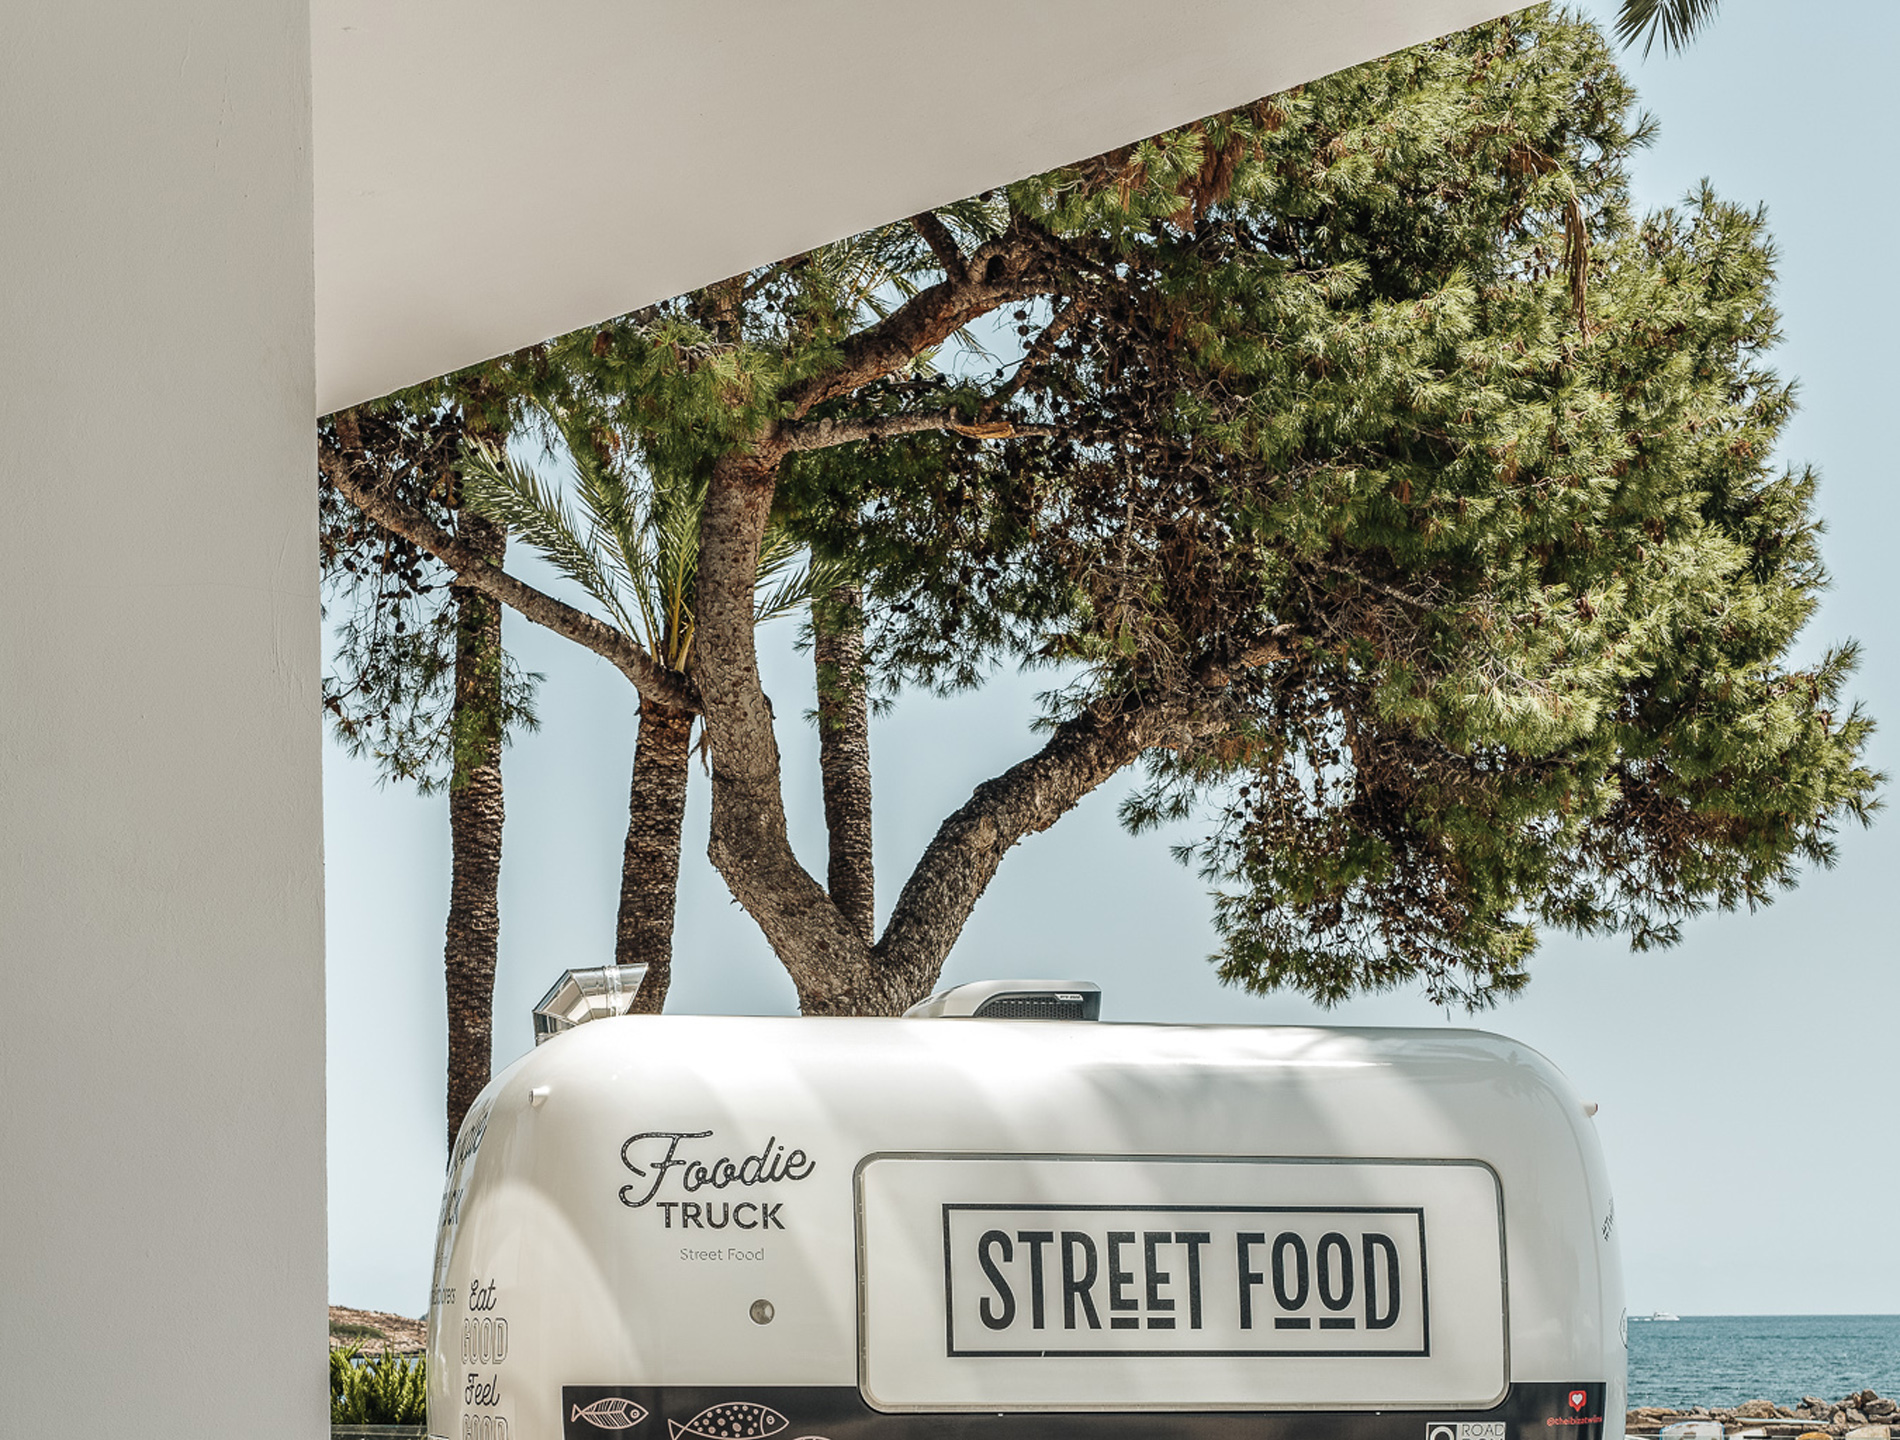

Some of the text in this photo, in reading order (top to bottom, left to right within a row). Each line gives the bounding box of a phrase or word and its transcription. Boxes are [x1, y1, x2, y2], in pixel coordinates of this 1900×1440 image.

[618, 1130, 816, 1207] Foodie
[657, 1202, 786, 1230] TRUCK
[679, 1247, 765, 1261] Street Food
[468, 1278, 497, 1311] Eat
[977, 1229, 1400, 1331] STREET FOOD
[464, 1373, 501, 1406] Feel
[1461, 1424, 1505, 1437] ROAD
